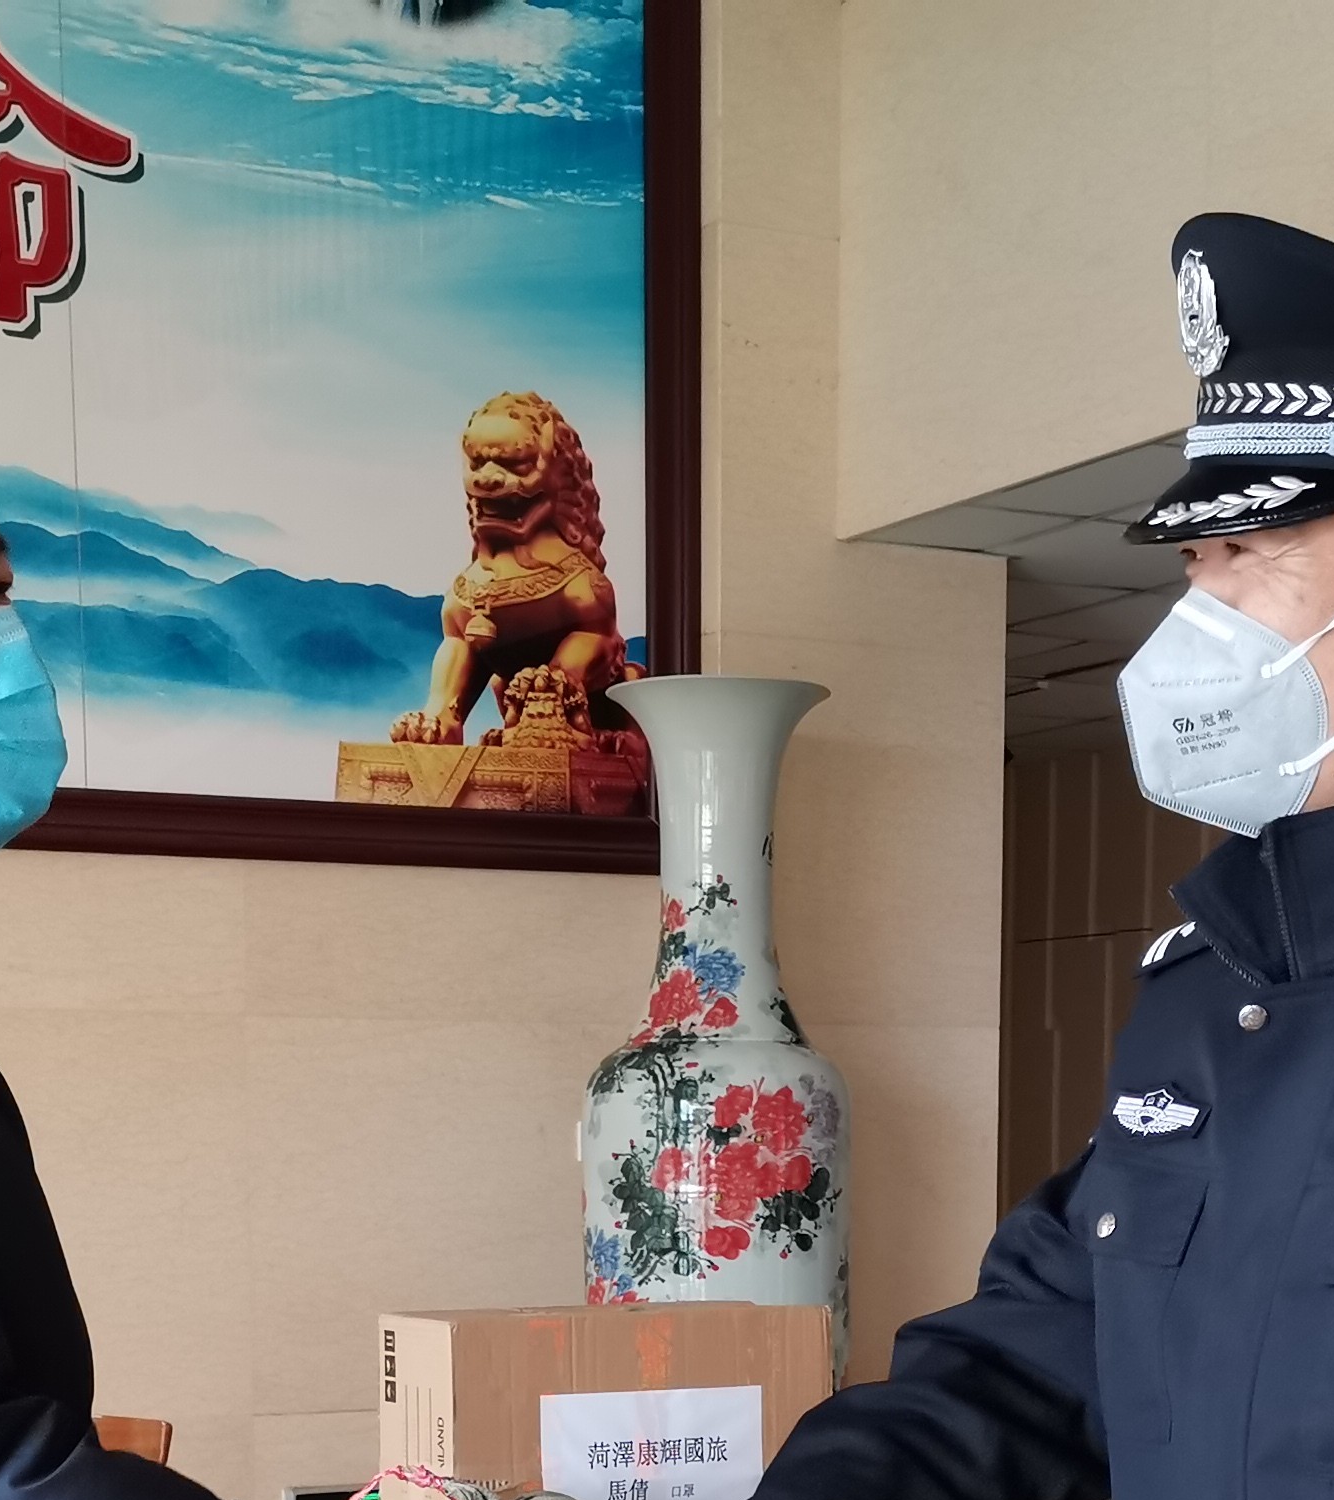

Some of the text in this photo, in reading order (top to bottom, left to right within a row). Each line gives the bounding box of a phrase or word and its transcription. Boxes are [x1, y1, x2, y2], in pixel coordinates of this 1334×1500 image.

[588, 1435, 728, 1469] 菏澤康輝國旅
[671, 1483, 695, 1498] 口罩
